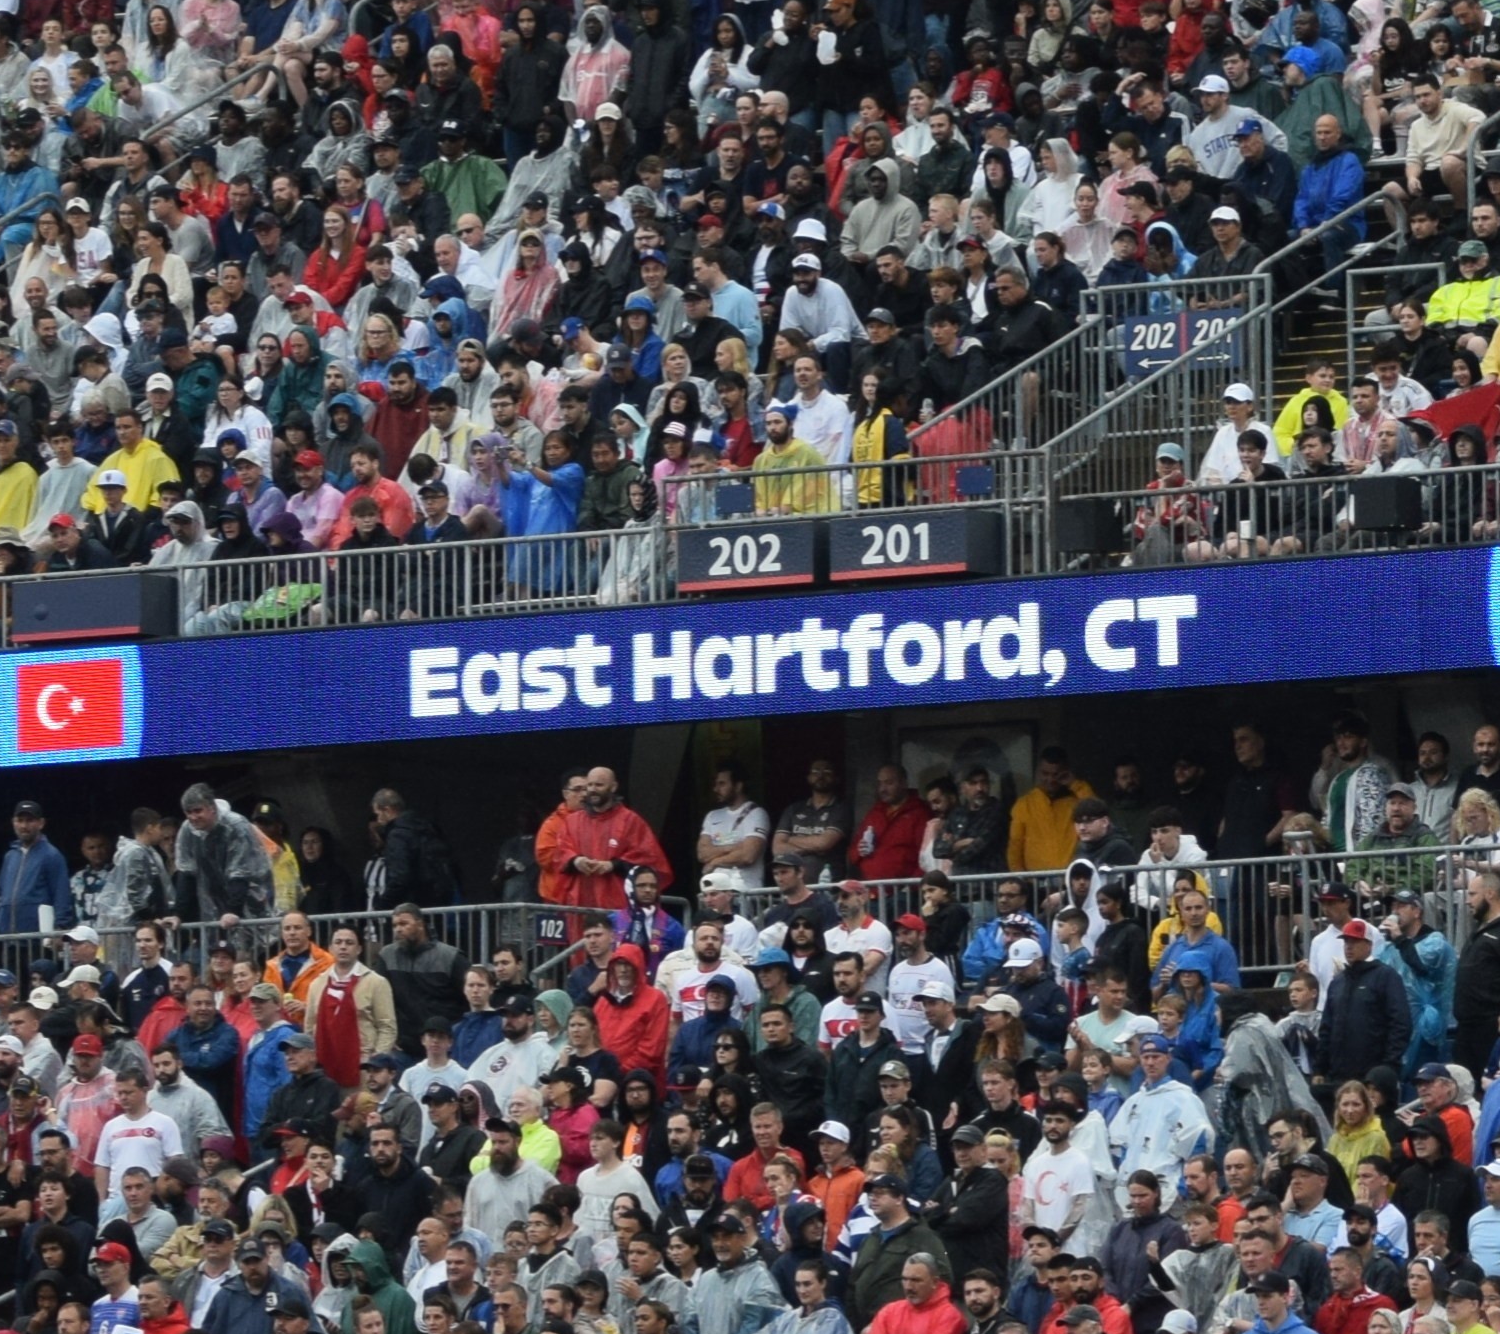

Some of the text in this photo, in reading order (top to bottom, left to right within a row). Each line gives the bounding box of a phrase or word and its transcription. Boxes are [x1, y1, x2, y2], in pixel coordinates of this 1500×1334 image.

[1131, 315, 1237, 351] 202 201
[709, 533, 782, 576] 202
[862, 522, 930, 565] 201
[409, 595, 1197, 717] East Hartford, CT
[540, 920, 562, 938] 102
